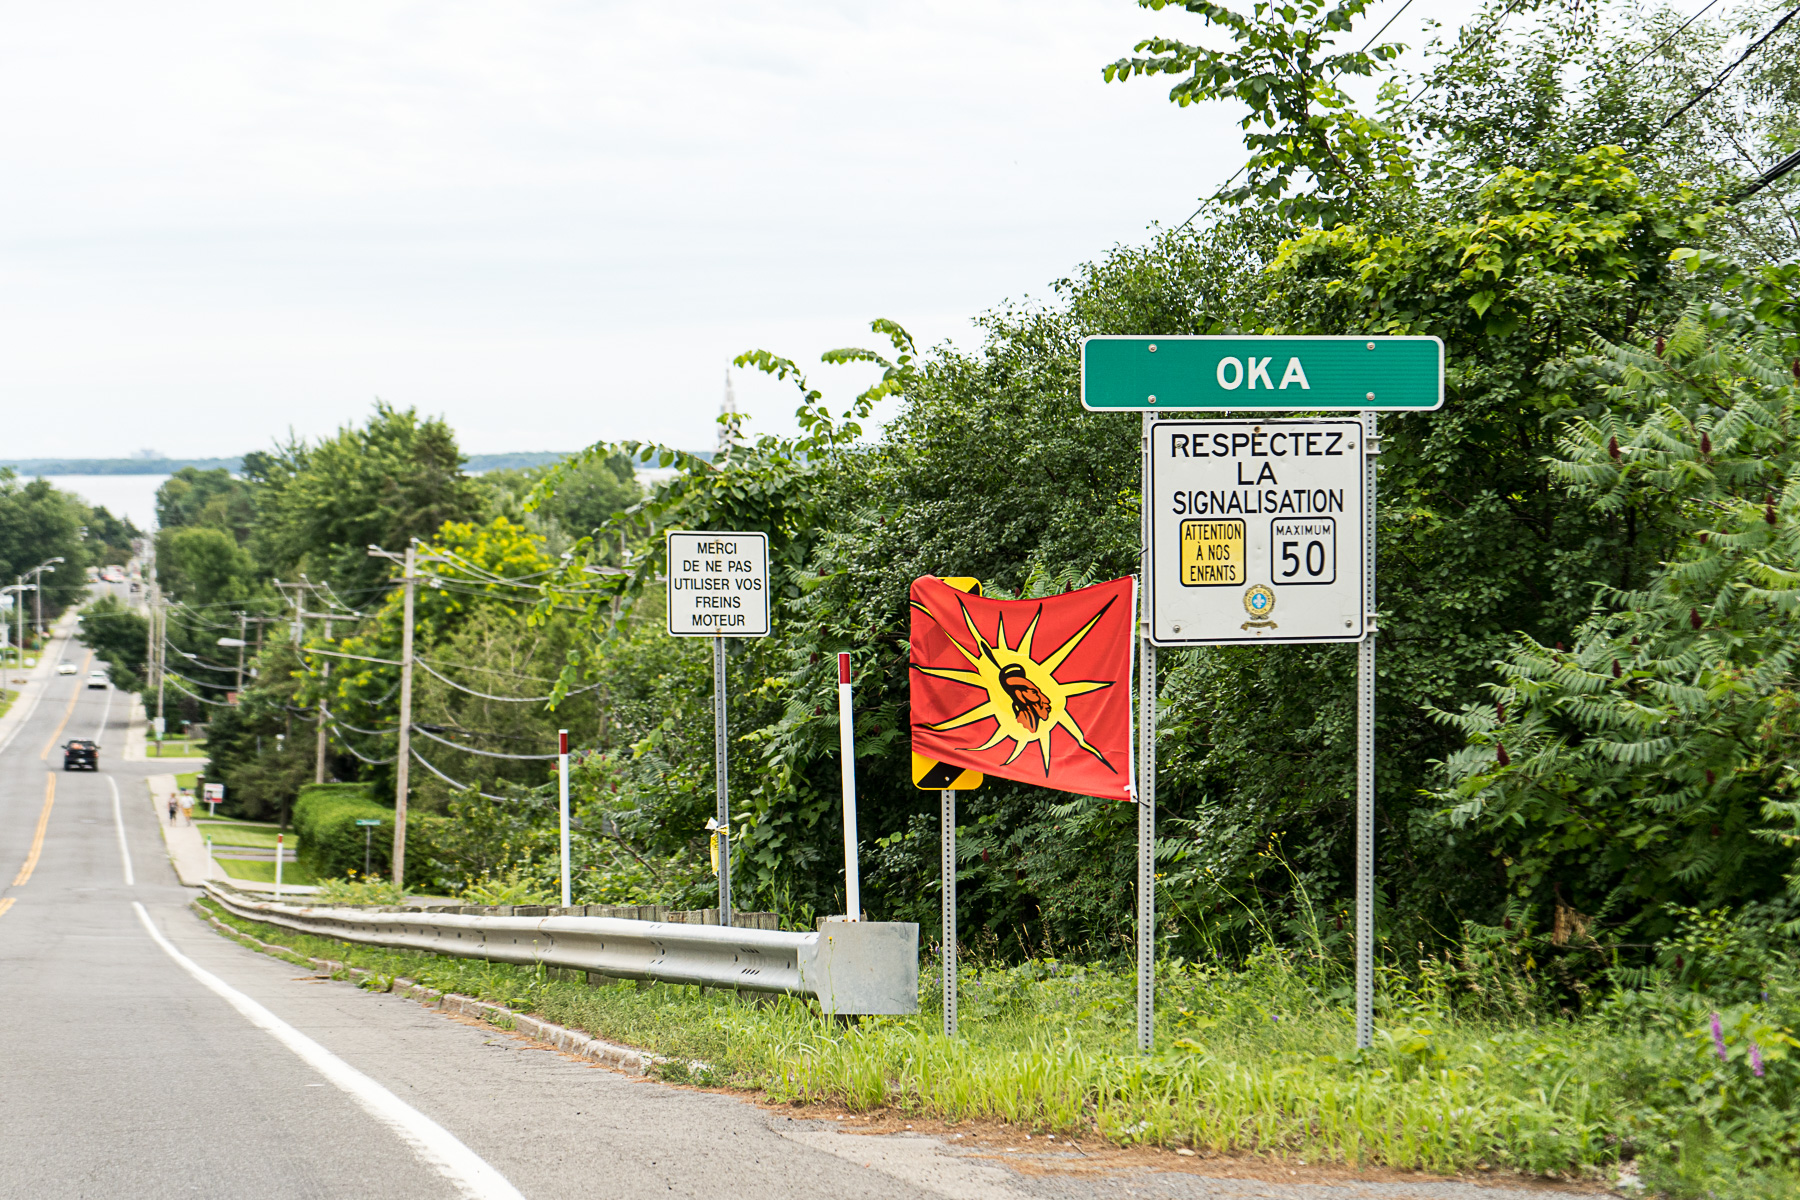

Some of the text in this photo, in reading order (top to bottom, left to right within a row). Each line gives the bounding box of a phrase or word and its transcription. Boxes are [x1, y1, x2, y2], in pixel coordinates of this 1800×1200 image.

[1216, 356, 1311, 390] OKA
[1171, 432, 1343, 458] RESPECTEZ
[1237, 461, 1278, 485] LA
[1172, 489, 1344, 515] SIGNALISATION
[1185, 523, 1241, 540] ATTENTION
[1276, 524, 1331, 536] MAXIMUM
[697, 542, 737, 554] MERCI
[1196, 541, 1230, 561] À NOS
[683, 560, 752, 572] DE NE PAS
[1282, 540, 1326, 577] 50
[1190, 564, 1236, 581] ENFANTS
[674, 578, 762, 590] UTILISER VOS
[695, 596, 741, 608] FREINS
[692, 614, 745, 626] MOTEUR
